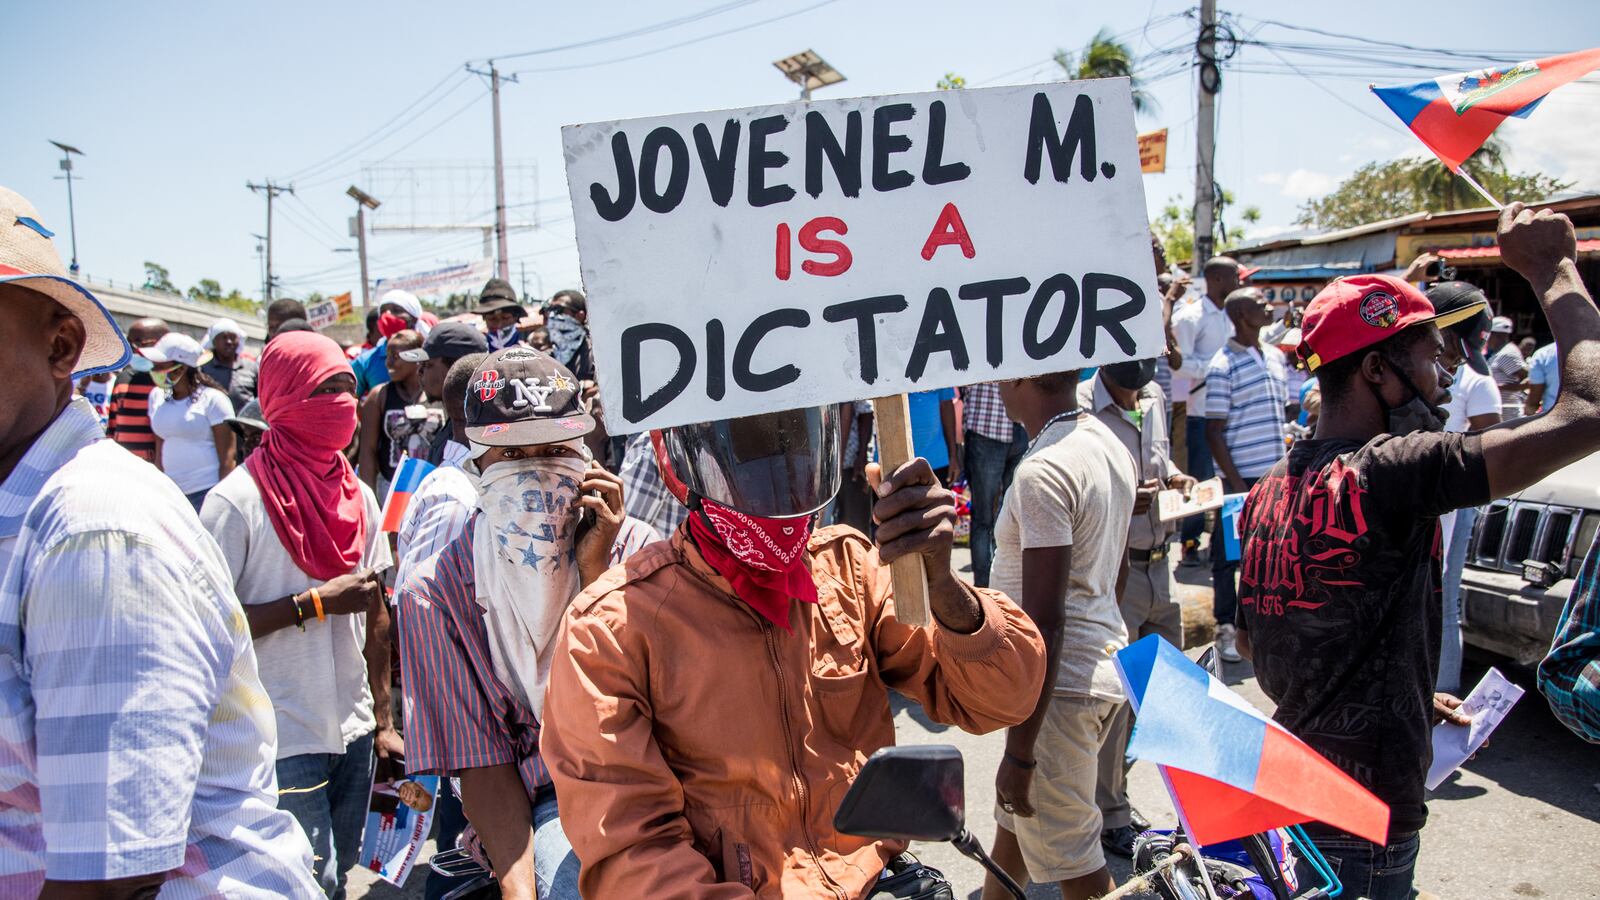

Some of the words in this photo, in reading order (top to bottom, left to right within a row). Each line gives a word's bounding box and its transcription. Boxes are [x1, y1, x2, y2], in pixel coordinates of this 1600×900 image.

[589, 100, 970, 221] JOVENEL
[1025, 93, 1116, 185] M.
[776, 216, 853, 281] IS
[920, 202, 975, 261] A
[509, 377, 553, 413] NY
[621, 272, 1146, 424] DICTATOR
